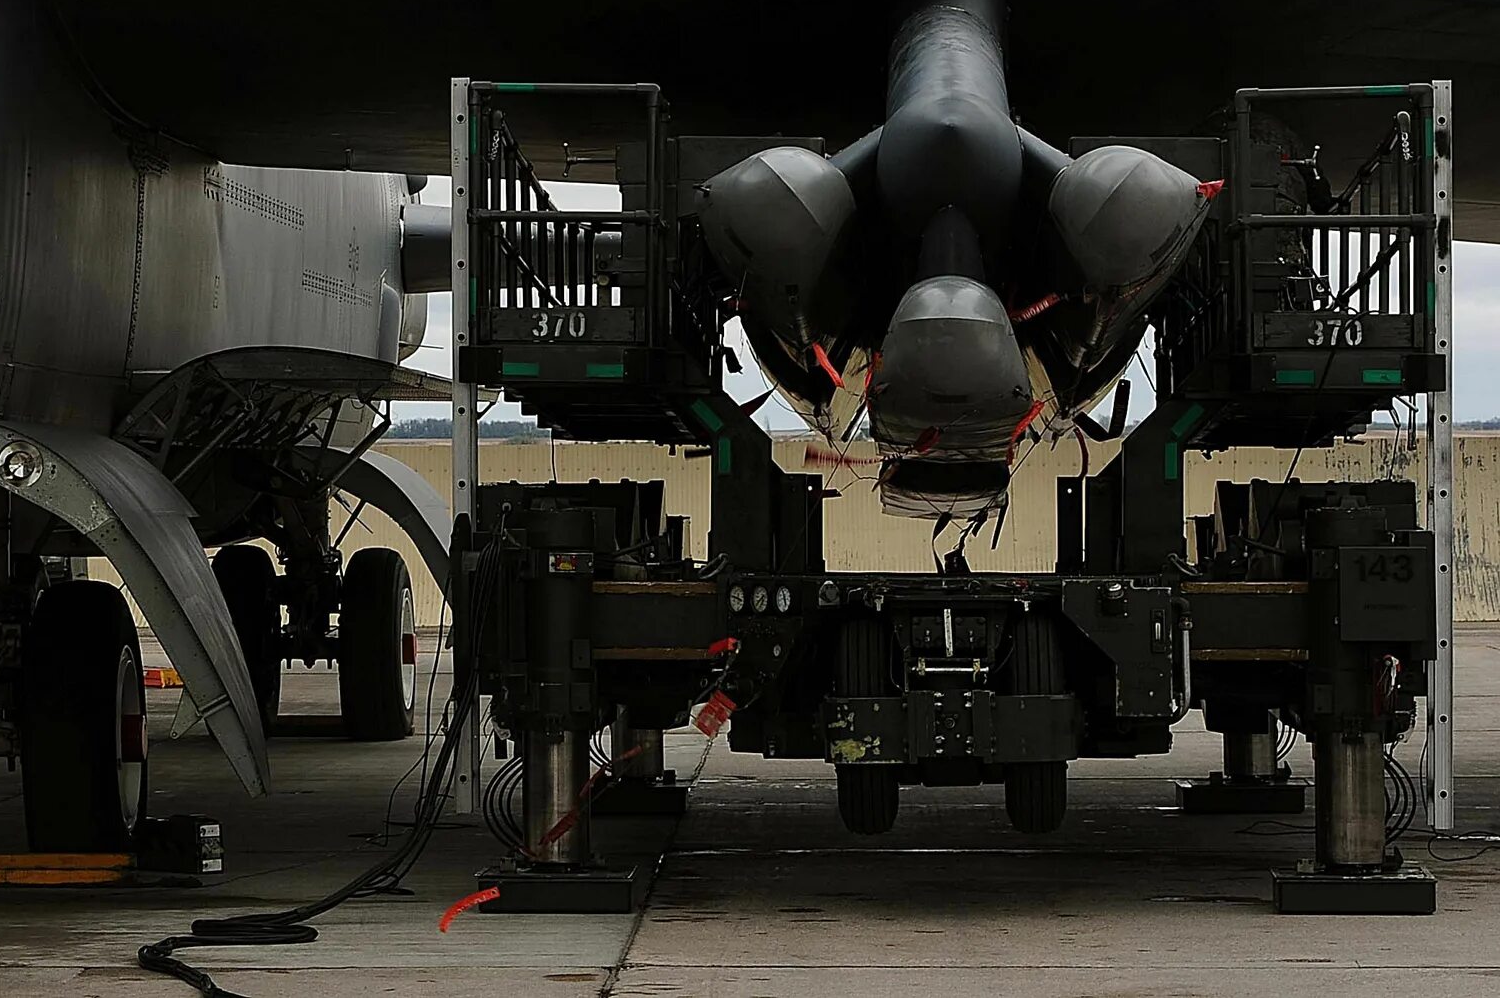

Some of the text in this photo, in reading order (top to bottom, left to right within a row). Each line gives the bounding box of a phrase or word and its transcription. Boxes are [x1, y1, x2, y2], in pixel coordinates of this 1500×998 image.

[533, 311, 586, 338] 370
[1307, 318, 1363, 346] 370
[1354, 554, 1414, 582] 143
